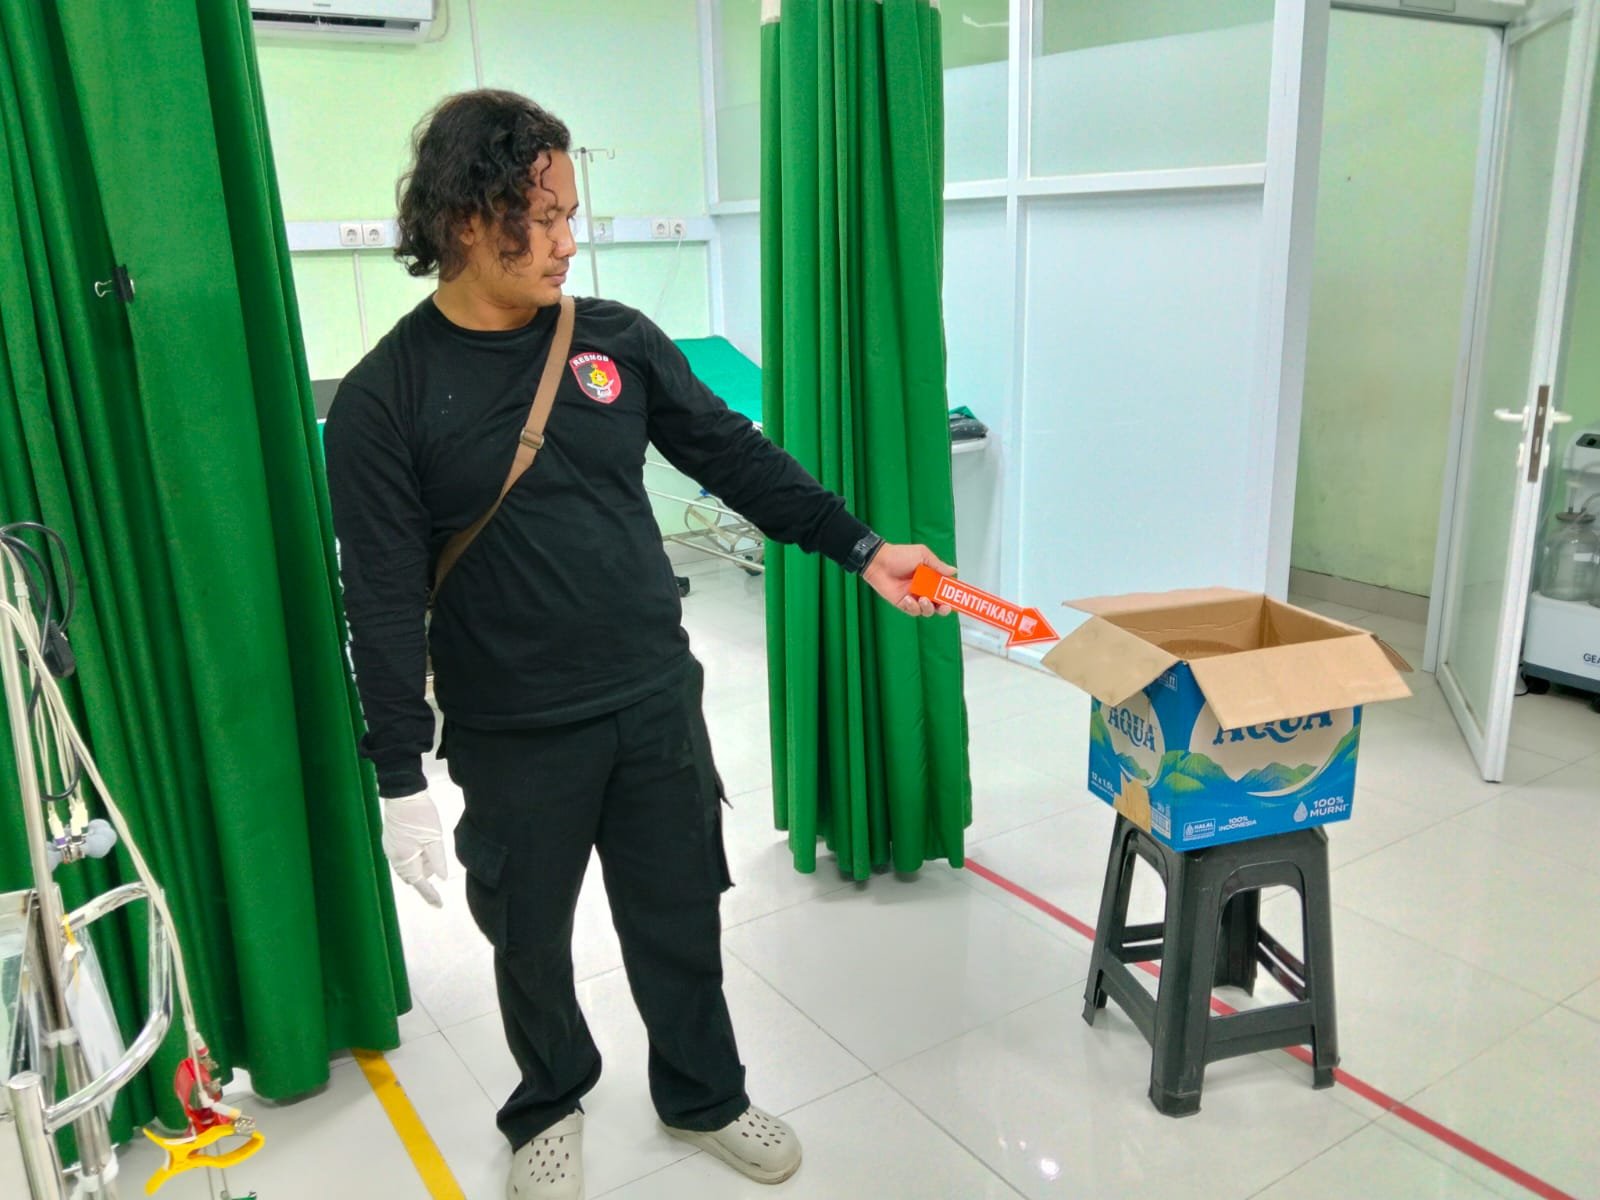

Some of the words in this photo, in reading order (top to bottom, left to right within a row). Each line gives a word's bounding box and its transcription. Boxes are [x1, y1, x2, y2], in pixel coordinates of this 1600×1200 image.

[573, 354, 609, 366] RESMOB
[941, 584, 1018, 626] IDENTIFIKASI
[1108, 707, 1156, 752] AQUA
[1313, 796, 1345, 808] 100%
[1310, 804, 1346, 818] MURNI
[1194, 822, 1213, 830] HALAL
[1218, 820, 1257, 832] INDONESIA
[1229, 816, 1248, 824] 100%
